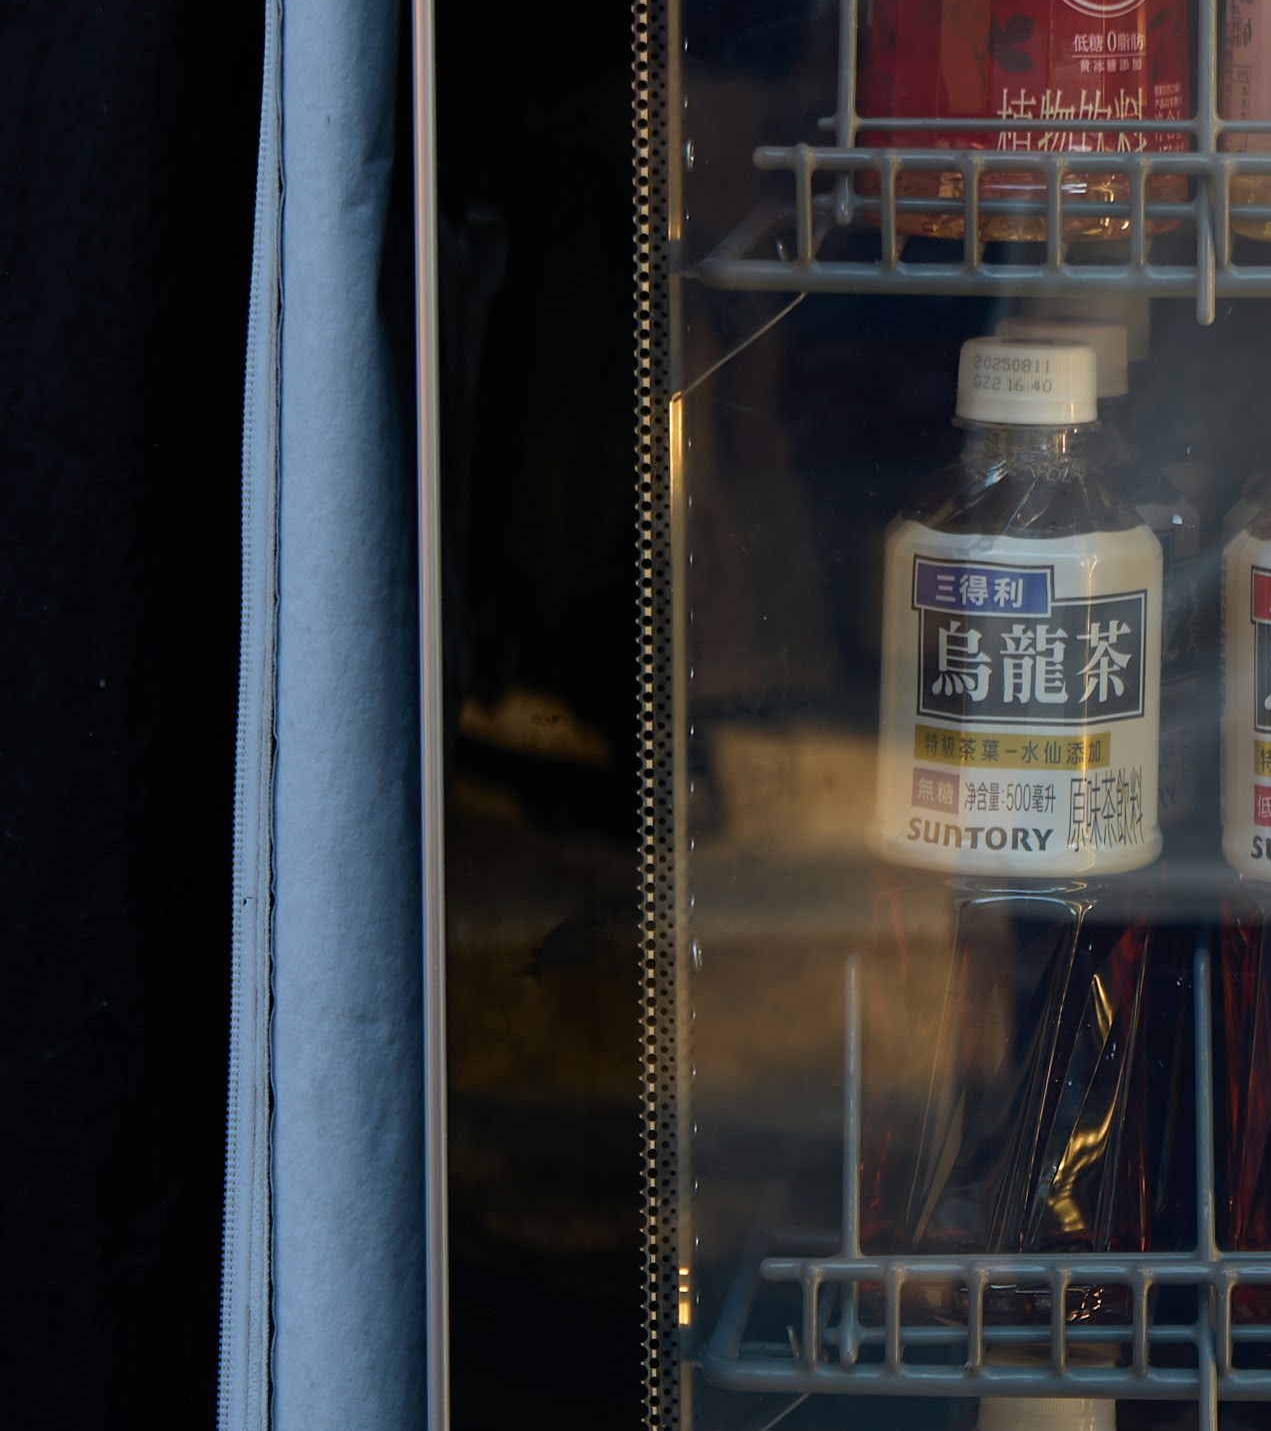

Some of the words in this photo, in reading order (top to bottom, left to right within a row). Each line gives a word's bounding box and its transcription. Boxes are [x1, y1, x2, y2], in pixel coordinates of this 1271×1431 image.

[1079, 58, 1143, 74] 黄冰糖添加
[934, 573, 1024, 609] 三得利
[930, 619, 1134, 705] 烏龍茶
[915, 778, 957, 807] 無糖
[906, 816, 1056, 853] SUNTORY
